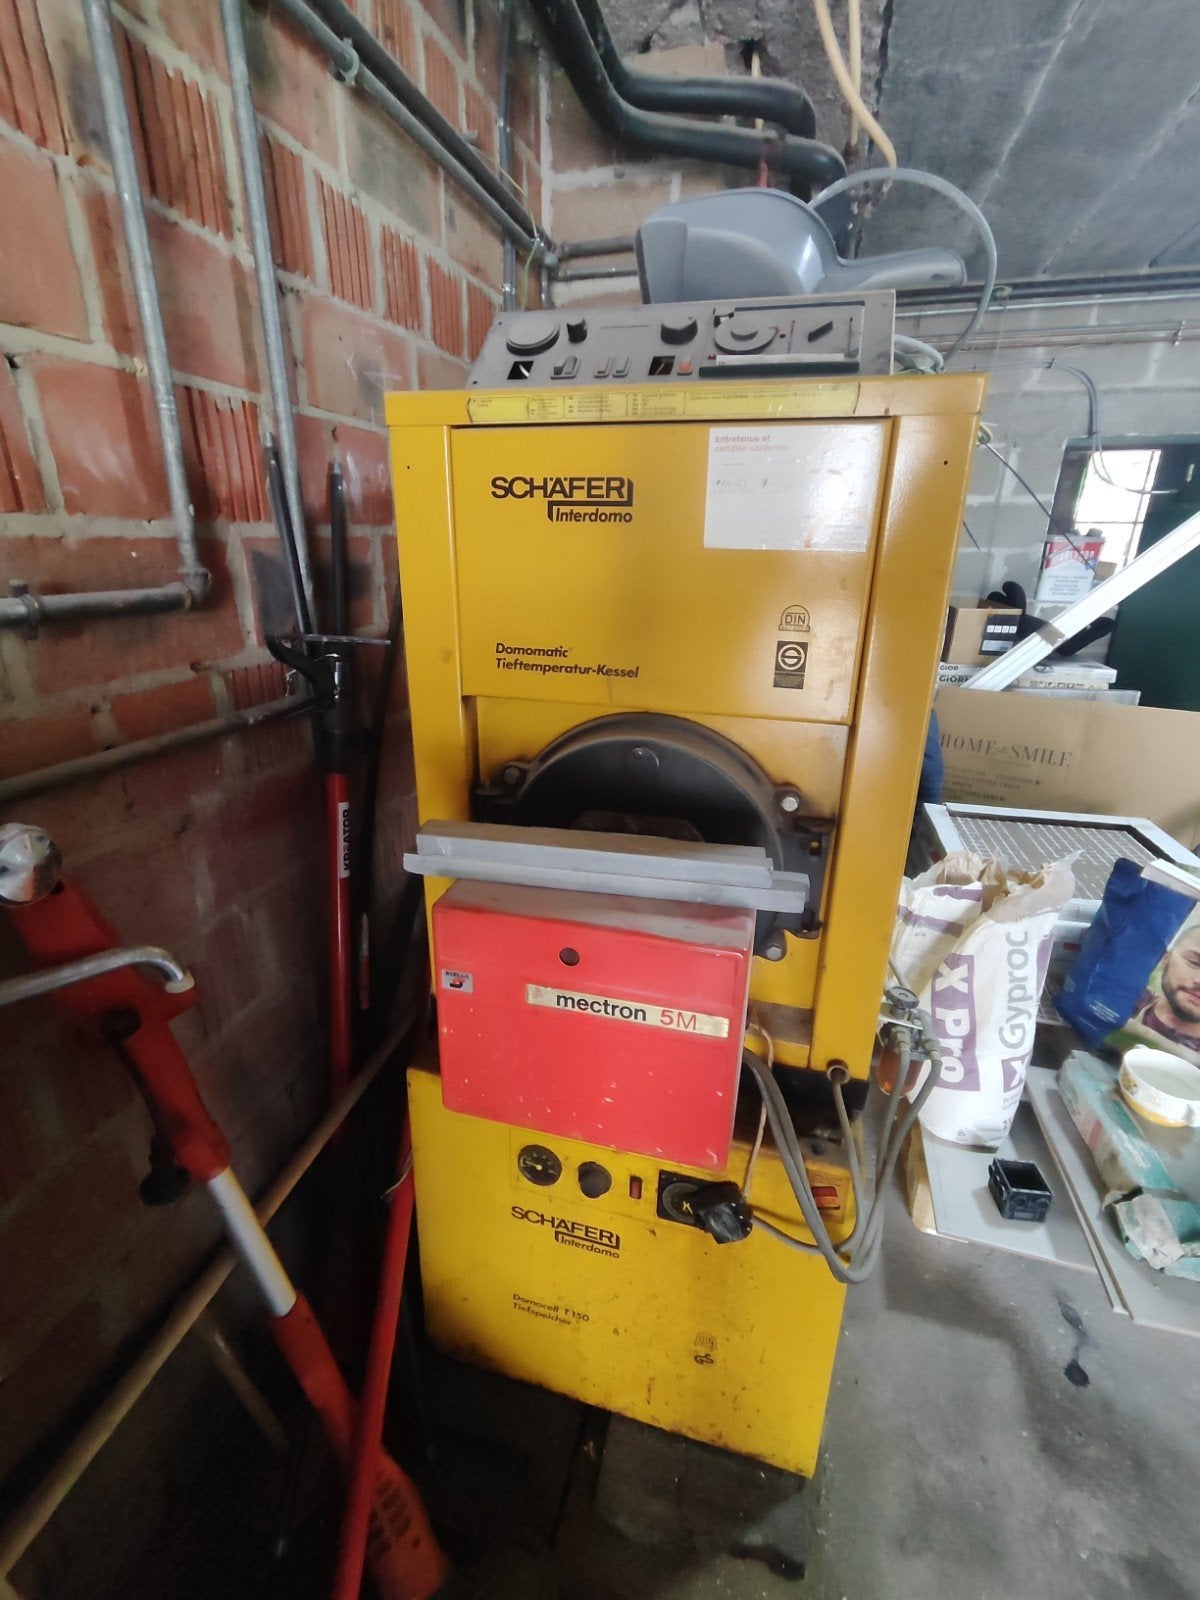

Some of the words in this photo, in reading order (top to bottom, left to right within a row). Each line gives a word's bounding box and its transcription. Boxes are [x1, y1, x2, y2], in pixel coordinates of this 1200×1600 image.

[715, 435, 760, 443] Entretenue
[491, 476, 626, 499] SCHÄFER
[556, 508, 633, 523] Interdomo
[784, 614, 806, 625] DIN
[495, 657, 640, 678] Tieftemperatur-Kessel
[1009, 744, 1073, 768] SMILE
[999, 930, 1033, 1050] Gyproc
[556, 994, 648, 1022] mectron
[660, 1009, 697, 1031] 5M
[935, 1007, 970, 1083] Pro
[511, 1205, 617, 1244] SCHÄFER
[560, 1236, 620, 1258] Interdomo
[513, 1293, 560, 1313] Domocell
[563, 1308, 570, 1316] T
[572, 1311, 590, 1322] 150
[513, 1302, 572, 1325] Tiefspeicher
